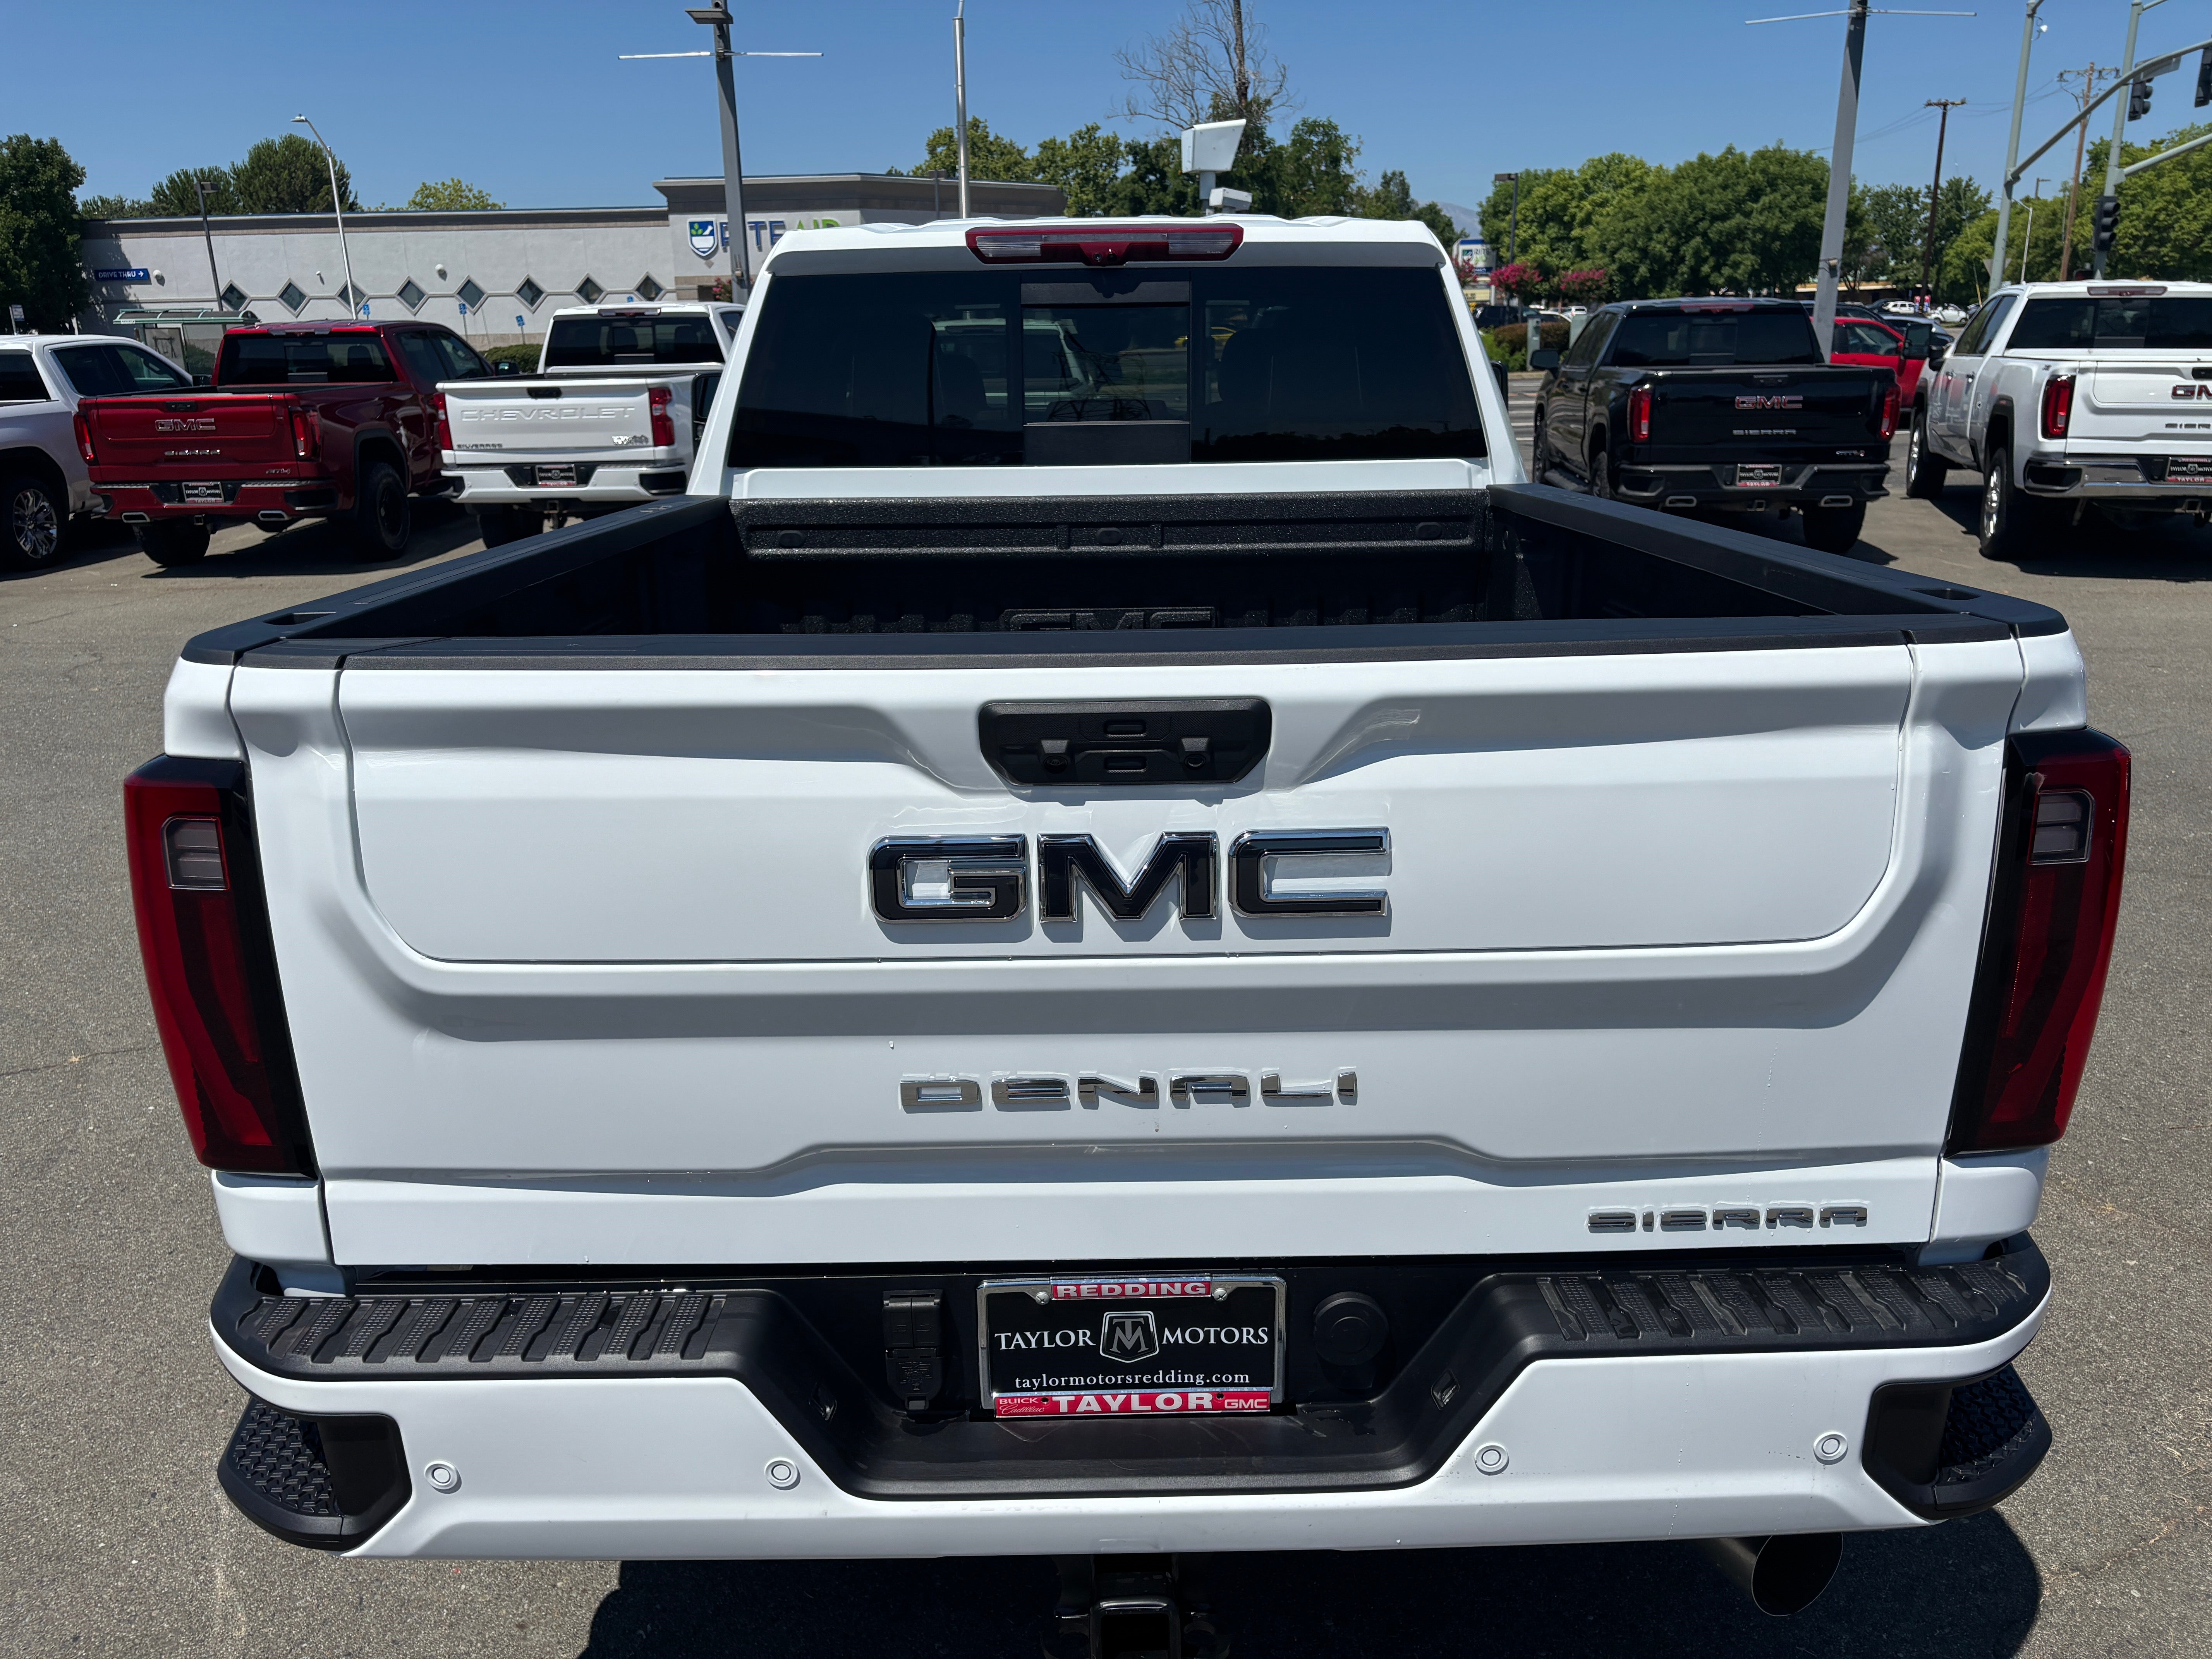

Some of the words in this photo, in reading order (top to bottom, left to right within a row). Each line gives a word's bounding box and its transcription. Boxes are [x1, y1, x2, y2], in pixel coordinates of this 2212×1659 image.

[720, 220, 785, 247] RTE
[1735, 395, 1803, 409] GMC
[461, 406, 635, 421] CHEVROLET
[155, 418, 216, 431] GMC
[868, 827, 1392, 925] GMC
[900, 1071, 1357, 1108] DENALI
[1588, 1206, 1868, 1233] SIERRA
[1057, 1283, 1206, 1297] REDDING
[994, 1329, 1096, 1350] TAYLOR
[1161, 1327, 1268, 1345] MOTORS
[1015, 1370, 1250, 1390] taylormotorsredding.com
[999, 1404, 1045, 1415] Cadillac
[1052, 1393, 1213, 1413] TAYLOR
[1224, 1399, 1267, 1409] GMC
